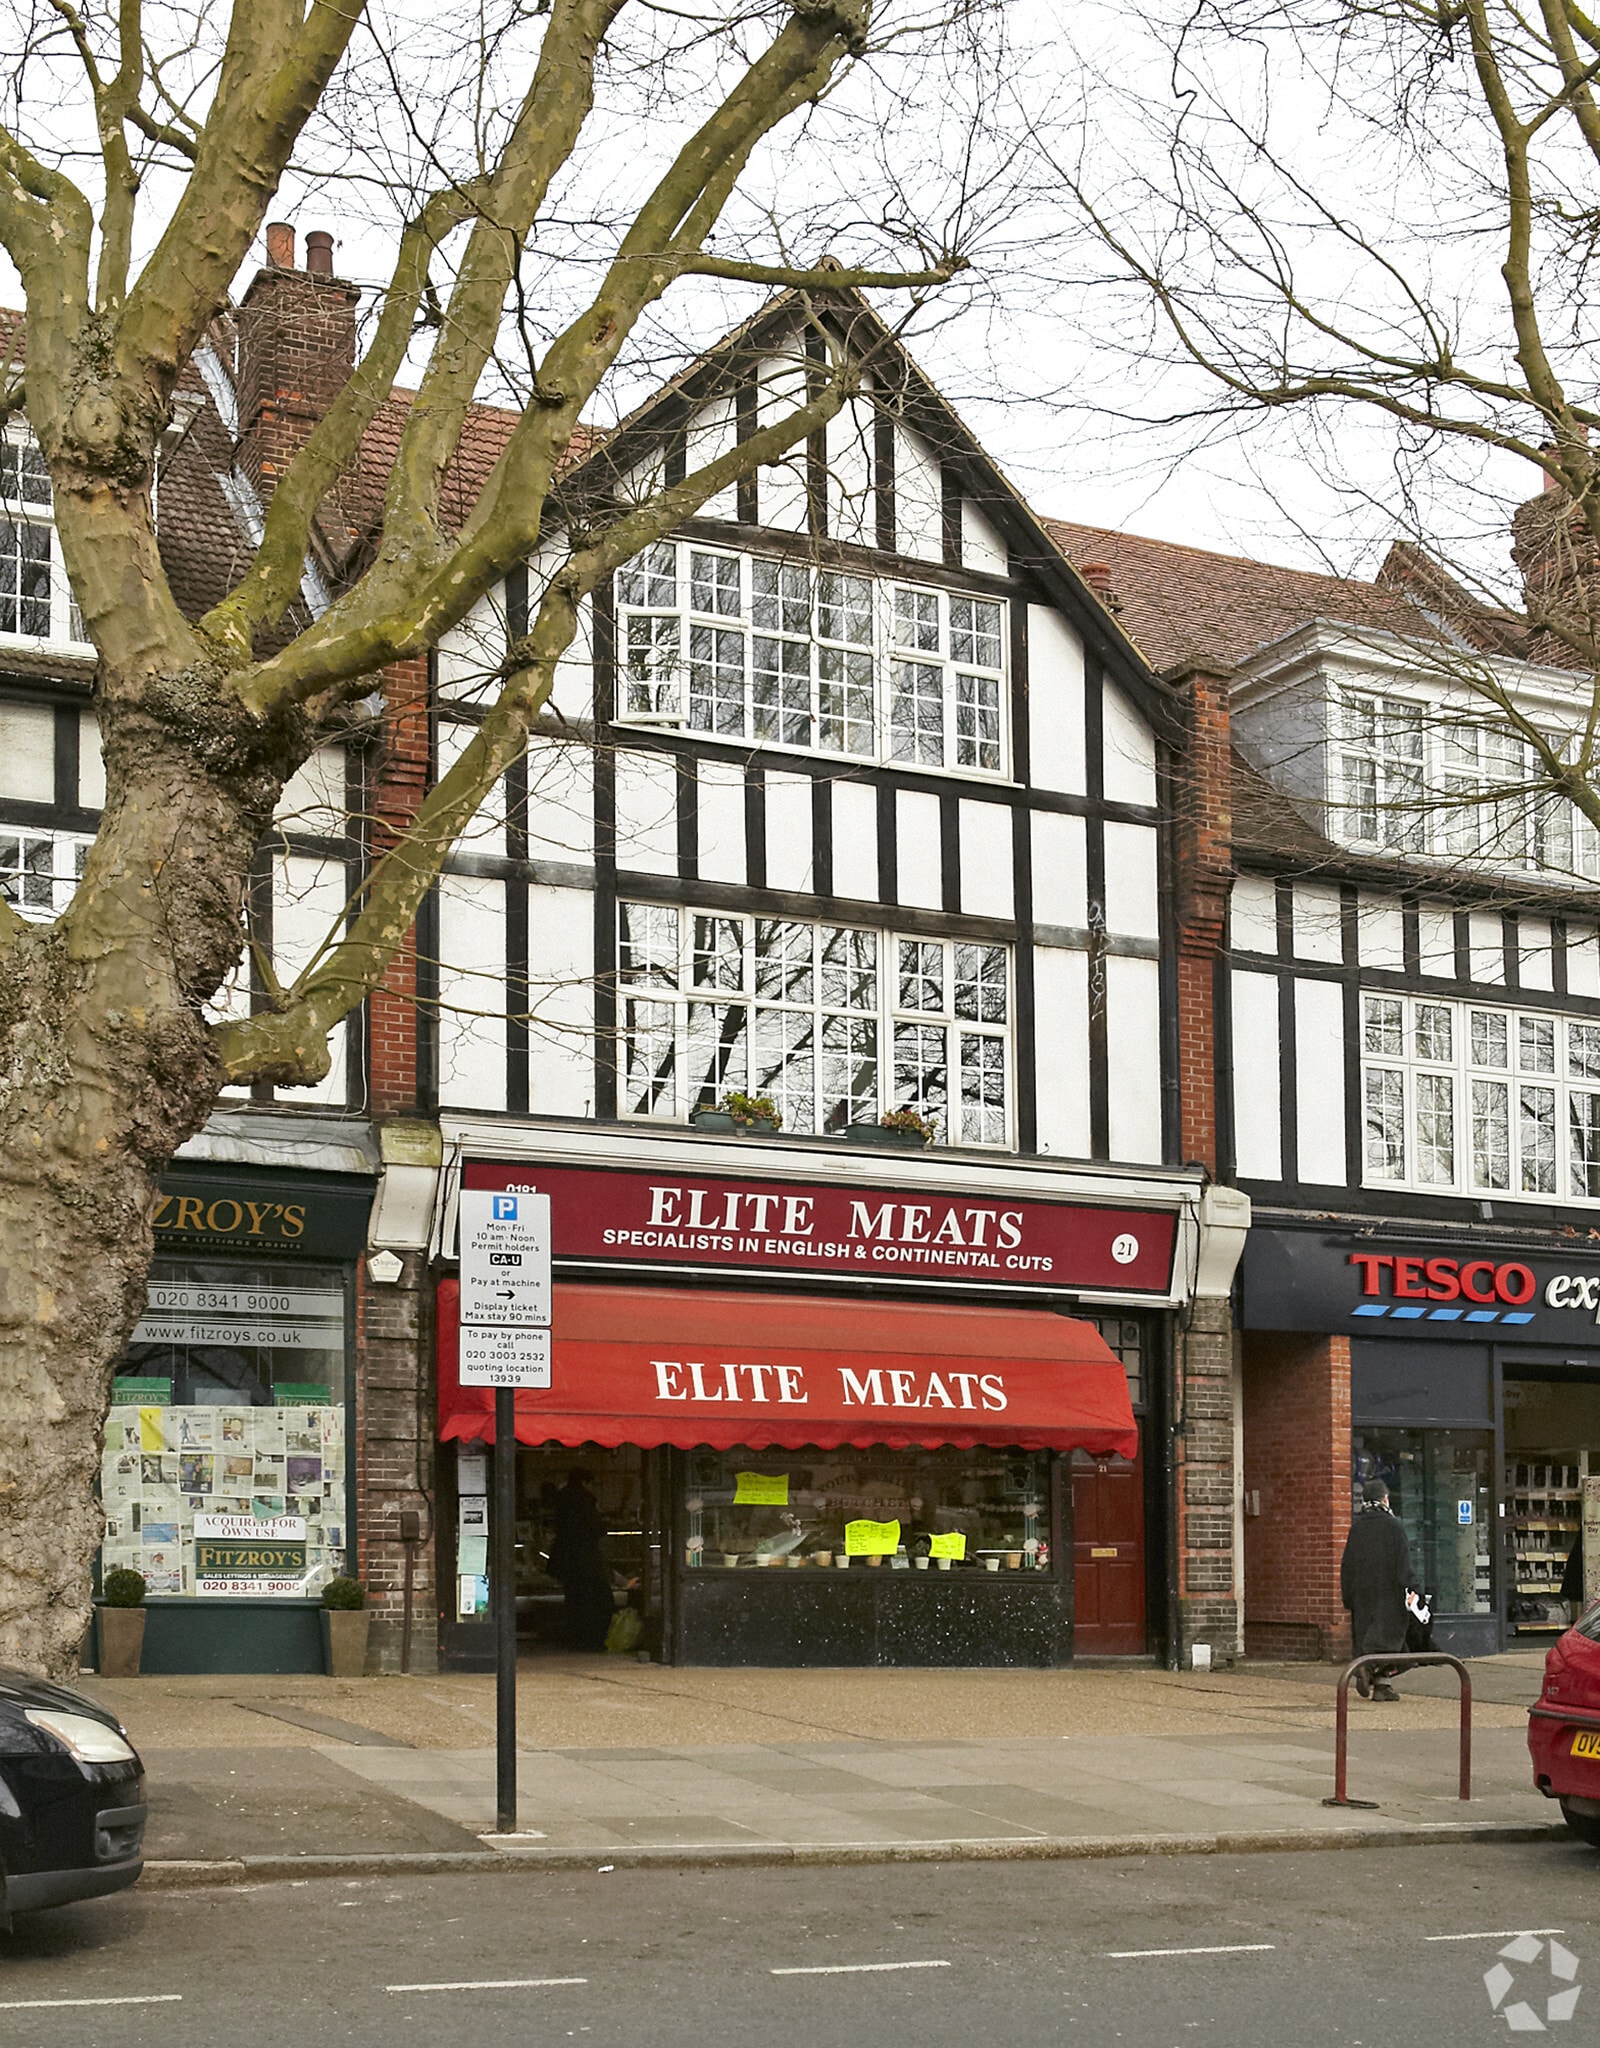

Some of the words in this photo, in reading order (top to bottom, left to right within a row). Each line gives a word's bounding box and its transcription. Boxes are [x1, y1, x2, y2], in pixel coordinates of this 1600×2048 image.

[498, 1199, 514, 1219] P
[646, 1186, 814, 1235] ELITE
[846, 1201, 1024, 1249] MEATS
[476, 1232, 488, 1240] 10
[195, 1236, 250, 1246] LETTINGS
[257, 1241, 301, 1249] AGENTS
[471, 1241, 502, 1251] Permit
[505, 1243, 540, 1252] holders
[602, 1229, 734, 1251] SPECIALISTS
[738, 1237, 759, 1252] IN
[764, 1239, 850, 1258] ENGLISH
[854, 1245, 867, 1259] &
[872, 1245, 1000, 1268] CONTINENTAL
[1005, 1254, 1053, 1271] CUTS
[1116, 1241, 1132, 1256] 21
[470, 1277, 488, 1287] Pay
[490, 1278, 500, 1286] at
[502, 1279, 541, 1287] machine
[1350, 1253, 1537, 1306] TESCO
[156, 1291, 189, 1307] 020
[196, 1293, 239, 1308] 8341
[247, 1296, 290, 1311] 9000
[474, 1302, 508, 1311] Display
[511, 1303, 538, 1312] ticket
[465, 1311, 485, 1320] Max
[487, 1312, 506, 1321] stay
[509, 1312, 523, 1321] 90
[525, 1313, 547, 1322] mins
[145, 1325, 301, 1344] www.fitzroys.co.uk
[467, 1330, 478, 1338] To
[481, 1332, 498, 1340] pay
[501, 1332, 512, 1340] by
[515, 1332, 543, 1341] phone
[496, 1341, 514, 1349] call
[465, 1350, 486, 1359] 020
[489, 1351, 517, 1360] 3003
[519, 1352, 545, 1361] 2532
[466, 1364, 503, 1373] quoting
[506, 1364, 544, 1373] location
[489, 1374, 522, 1383] 13939
[650, 1361, 808, 1403] ELITE
[837, 1368, 1008, 1411] MEATS
[114, 1390, 169, 1402] FITZROY'S
[272, 1519, 297, 1528] FOR
[221, 1527, 252, 1537] OWN
[255, 1528, 279, 1537] USE
[200, 1547, 303, 1567] FITZROY'S
[202, 1581, 228, 1590] 020
[231, 1581, 262, 1590] 8341
